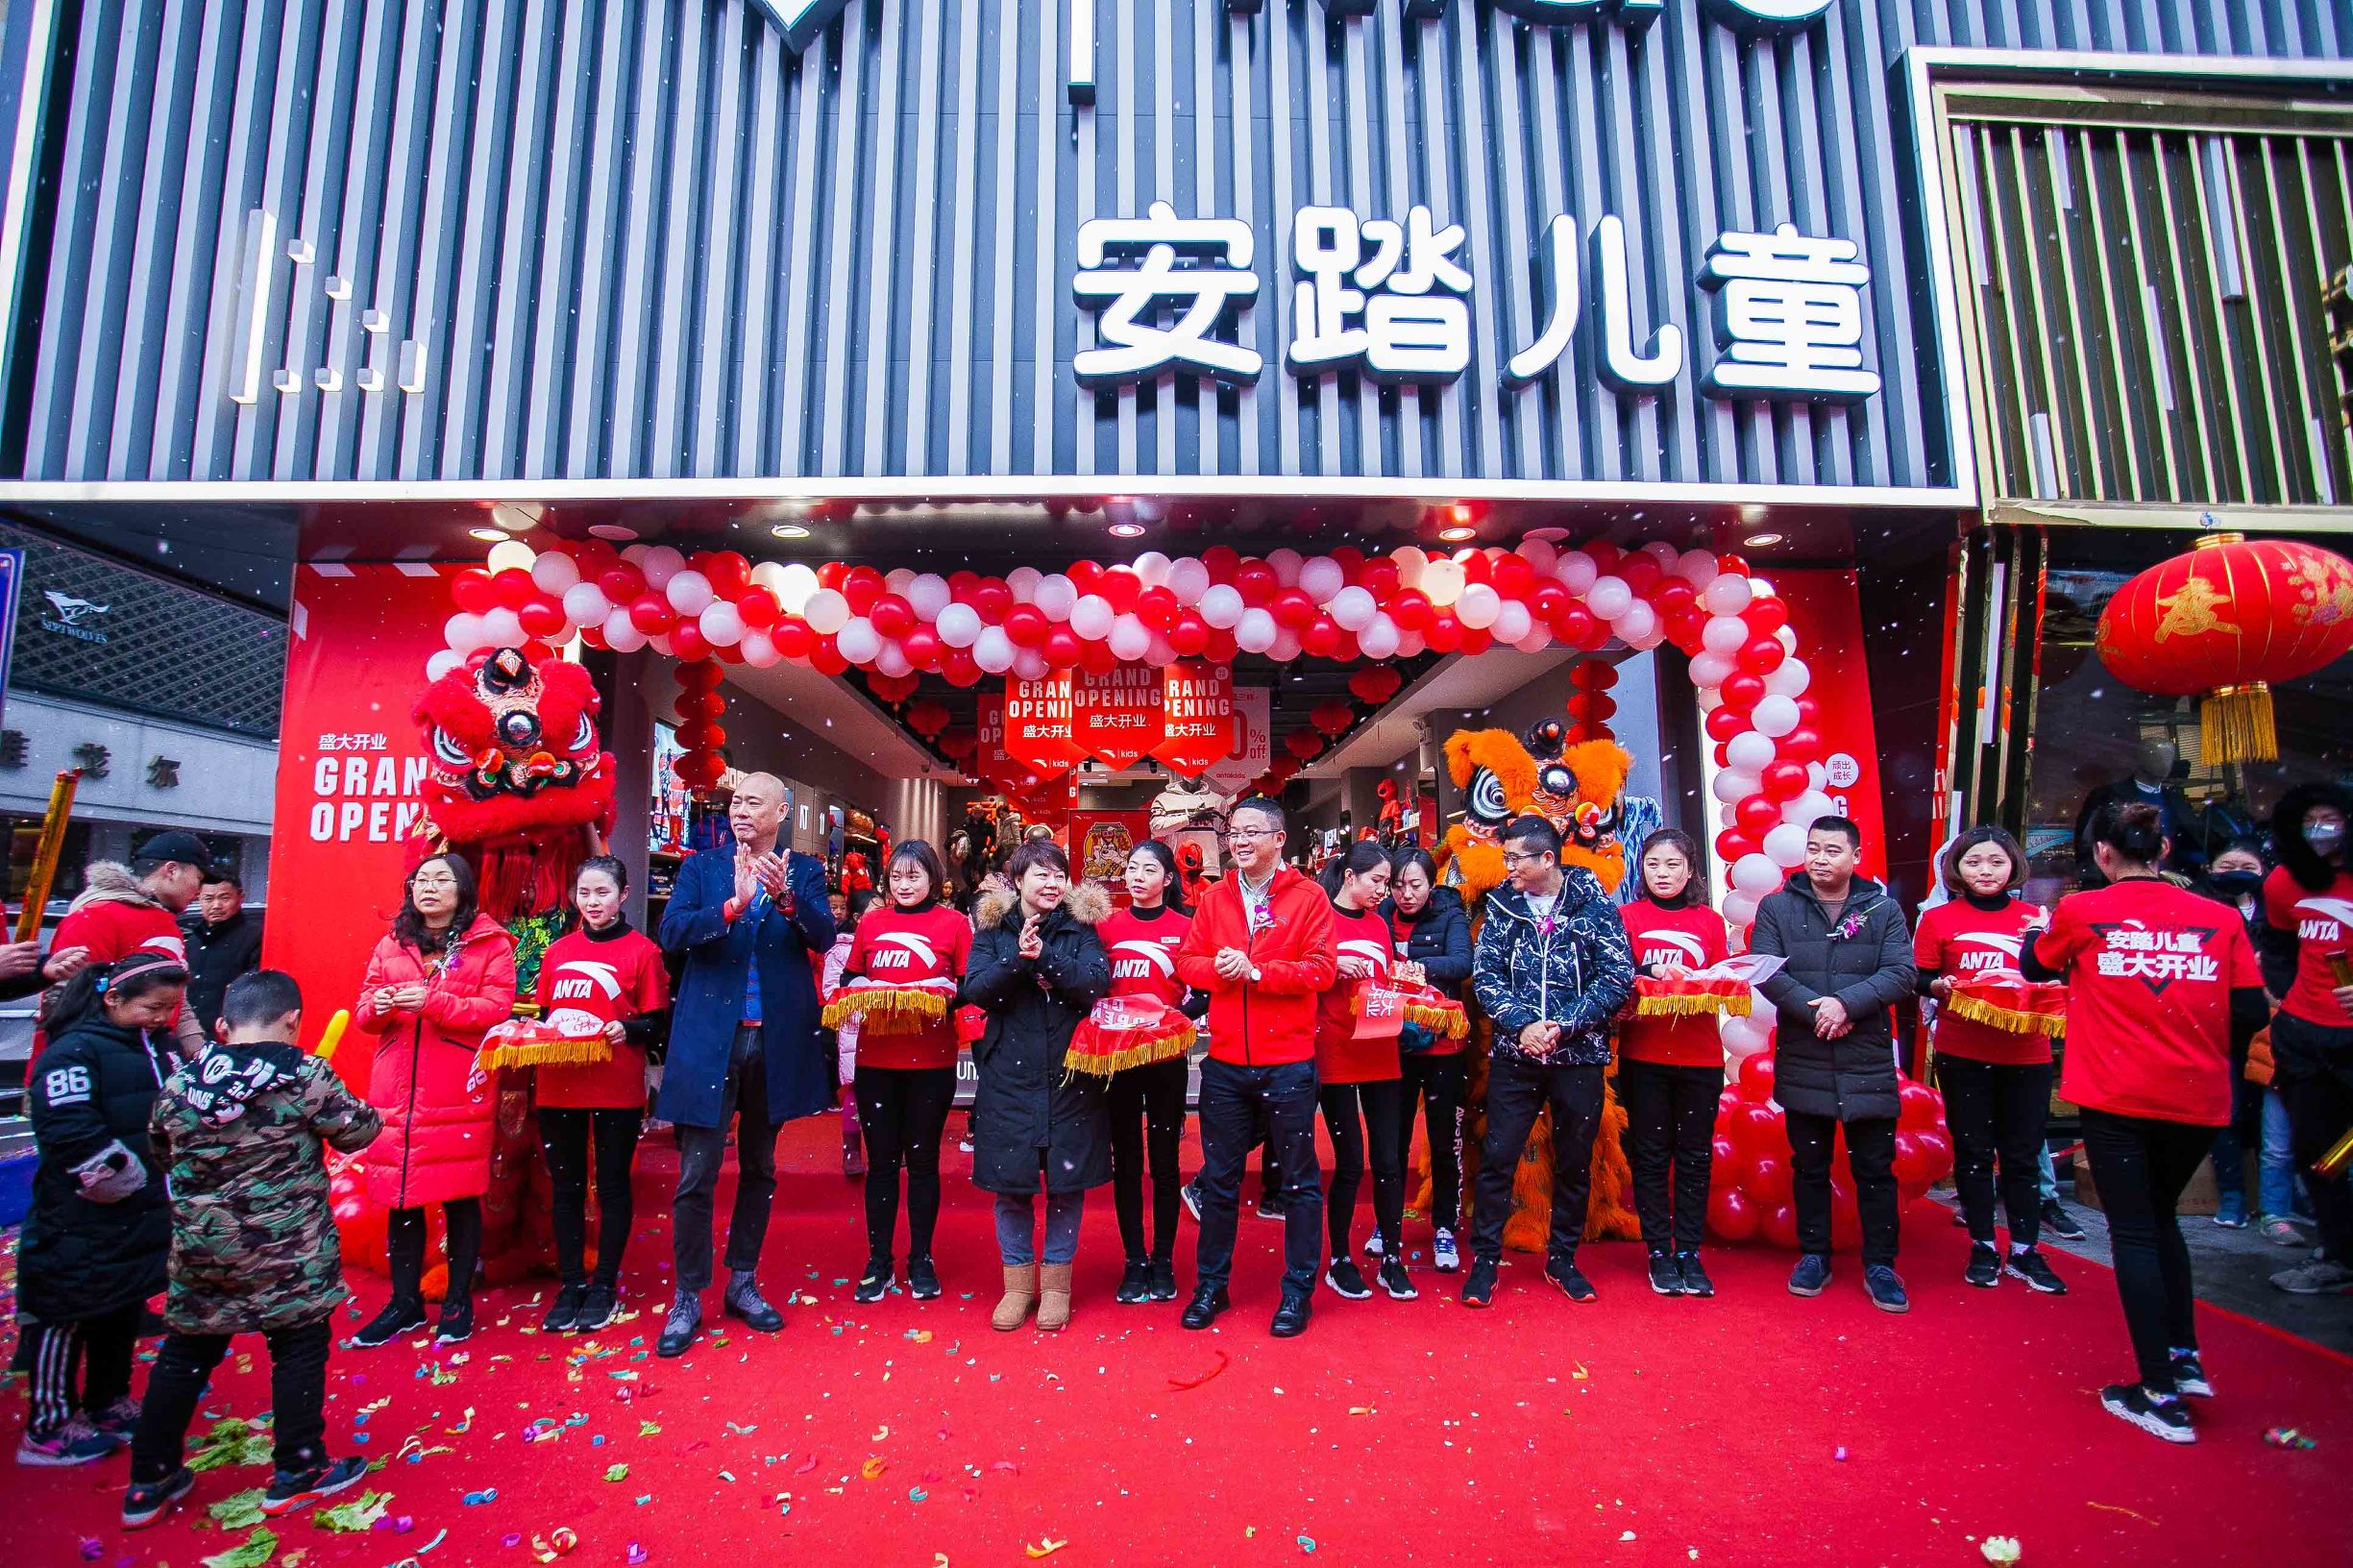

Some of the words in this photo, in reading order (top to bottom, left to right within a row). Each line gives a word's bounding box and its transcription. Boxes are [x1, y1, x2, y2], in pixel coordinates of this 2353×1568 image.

[1073, 201, 1881, 396] 安踏儿童
[1074, 689, 1162, 707] OPENING
[1164, 679, 1220, 698] RAND
[1090, 714, 1147, 728] 盛大开业
[318, 733, 387, 750] 盛大开业
[1121, 748, 1139, 758] kids
[1192, 758, 1209, 767] kids
[1052, 759, 1069, 768] kids
[2298, 919, 2340, 942] ANTA
[2106, 930, 2203, 953] 安踏儿童
[871, 949, 910, 968] ANTA
[1959, 950, 2005, 969] ANTA
[2097, 952, 2218, 982] 盛大开业
[1113, 959, 1151, 979] ANTA
[552, 978, 594, 1000] ANTA
[47, 1066, 91, 1098] 86
